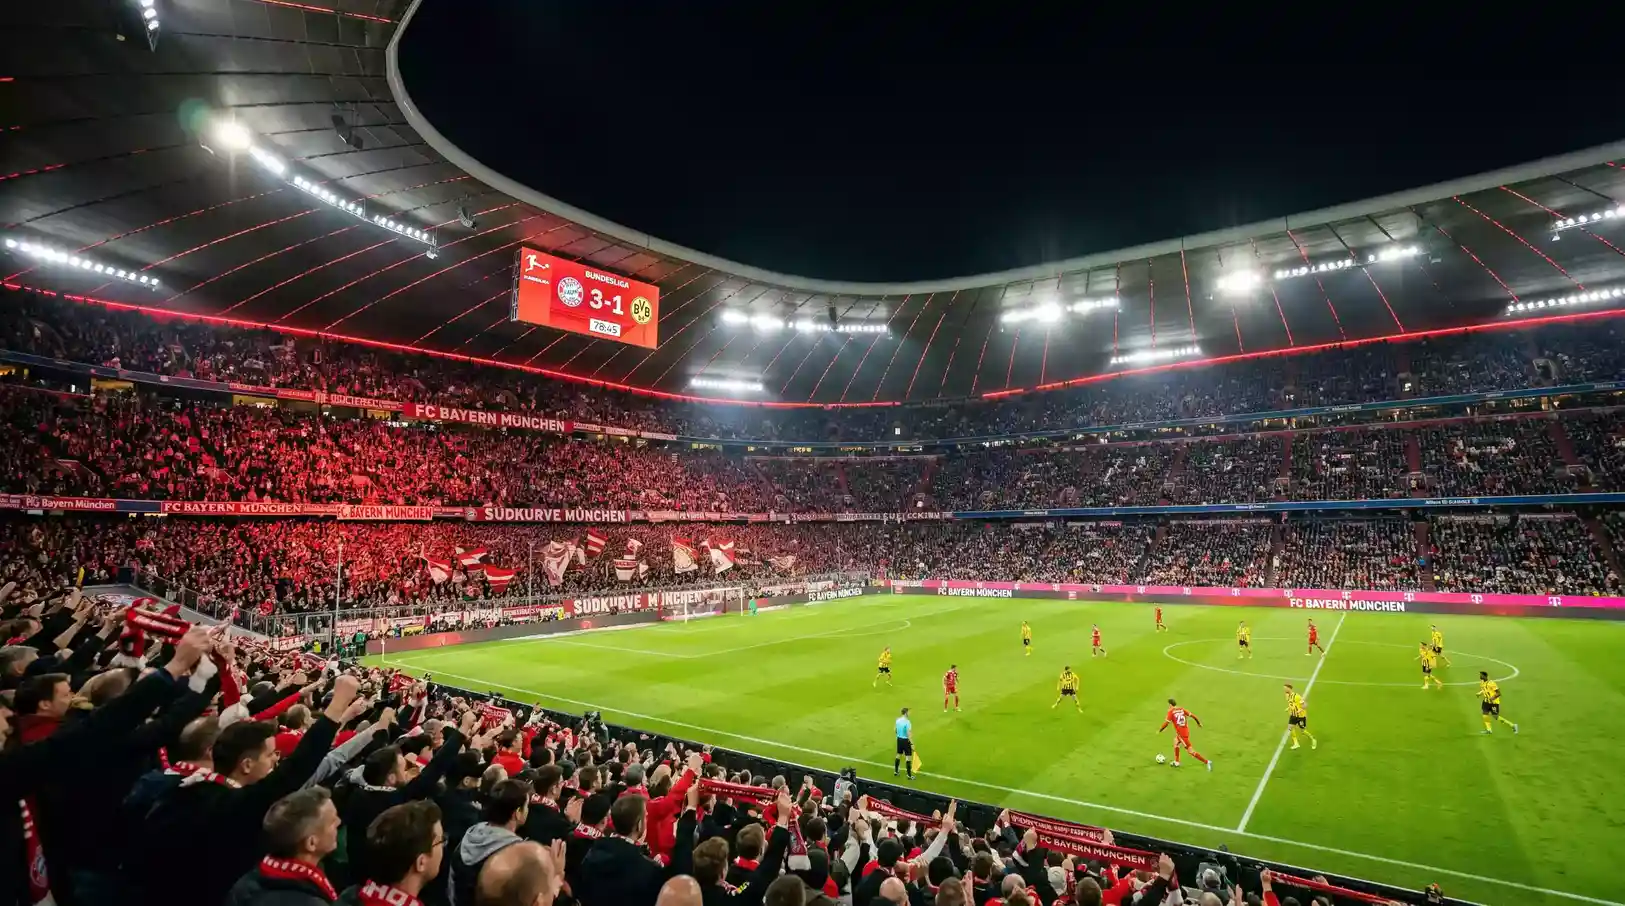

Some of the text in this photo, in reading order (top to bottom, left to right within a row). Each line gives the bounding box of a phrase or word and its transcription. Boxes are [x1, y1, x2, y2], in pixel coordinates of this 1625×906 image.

[585, 270, 629, 289] BUNDESLIGA
[589, 288, 624, 315] 3-1
[593, 320, 618, 334] 78:45
[415, 404, 436, 418] FC
[440, 407, 497, 425] BAYERN
[501, 413, 565, 432] MÜNCHEN
[41, 498, 74, 509] Bayern
[75, 500, 115, 509] München
[164, 502, 181, 512] FC
[184, 502, 235, 513] BAYERN
[350, 506, 383, 518] BAYERN
[565, 506, 626, 522] MÜNCHEN
[937, 587, 947, 596] FC
[948, 587, 975, 597] BAYERN
[1289, 598, 1303, 608] FC
[1305, 599, 1348, 610] BAYERN
[1039, 834, 1052, 845] FC
[1053, 837, 1091, 855] BAYERN
